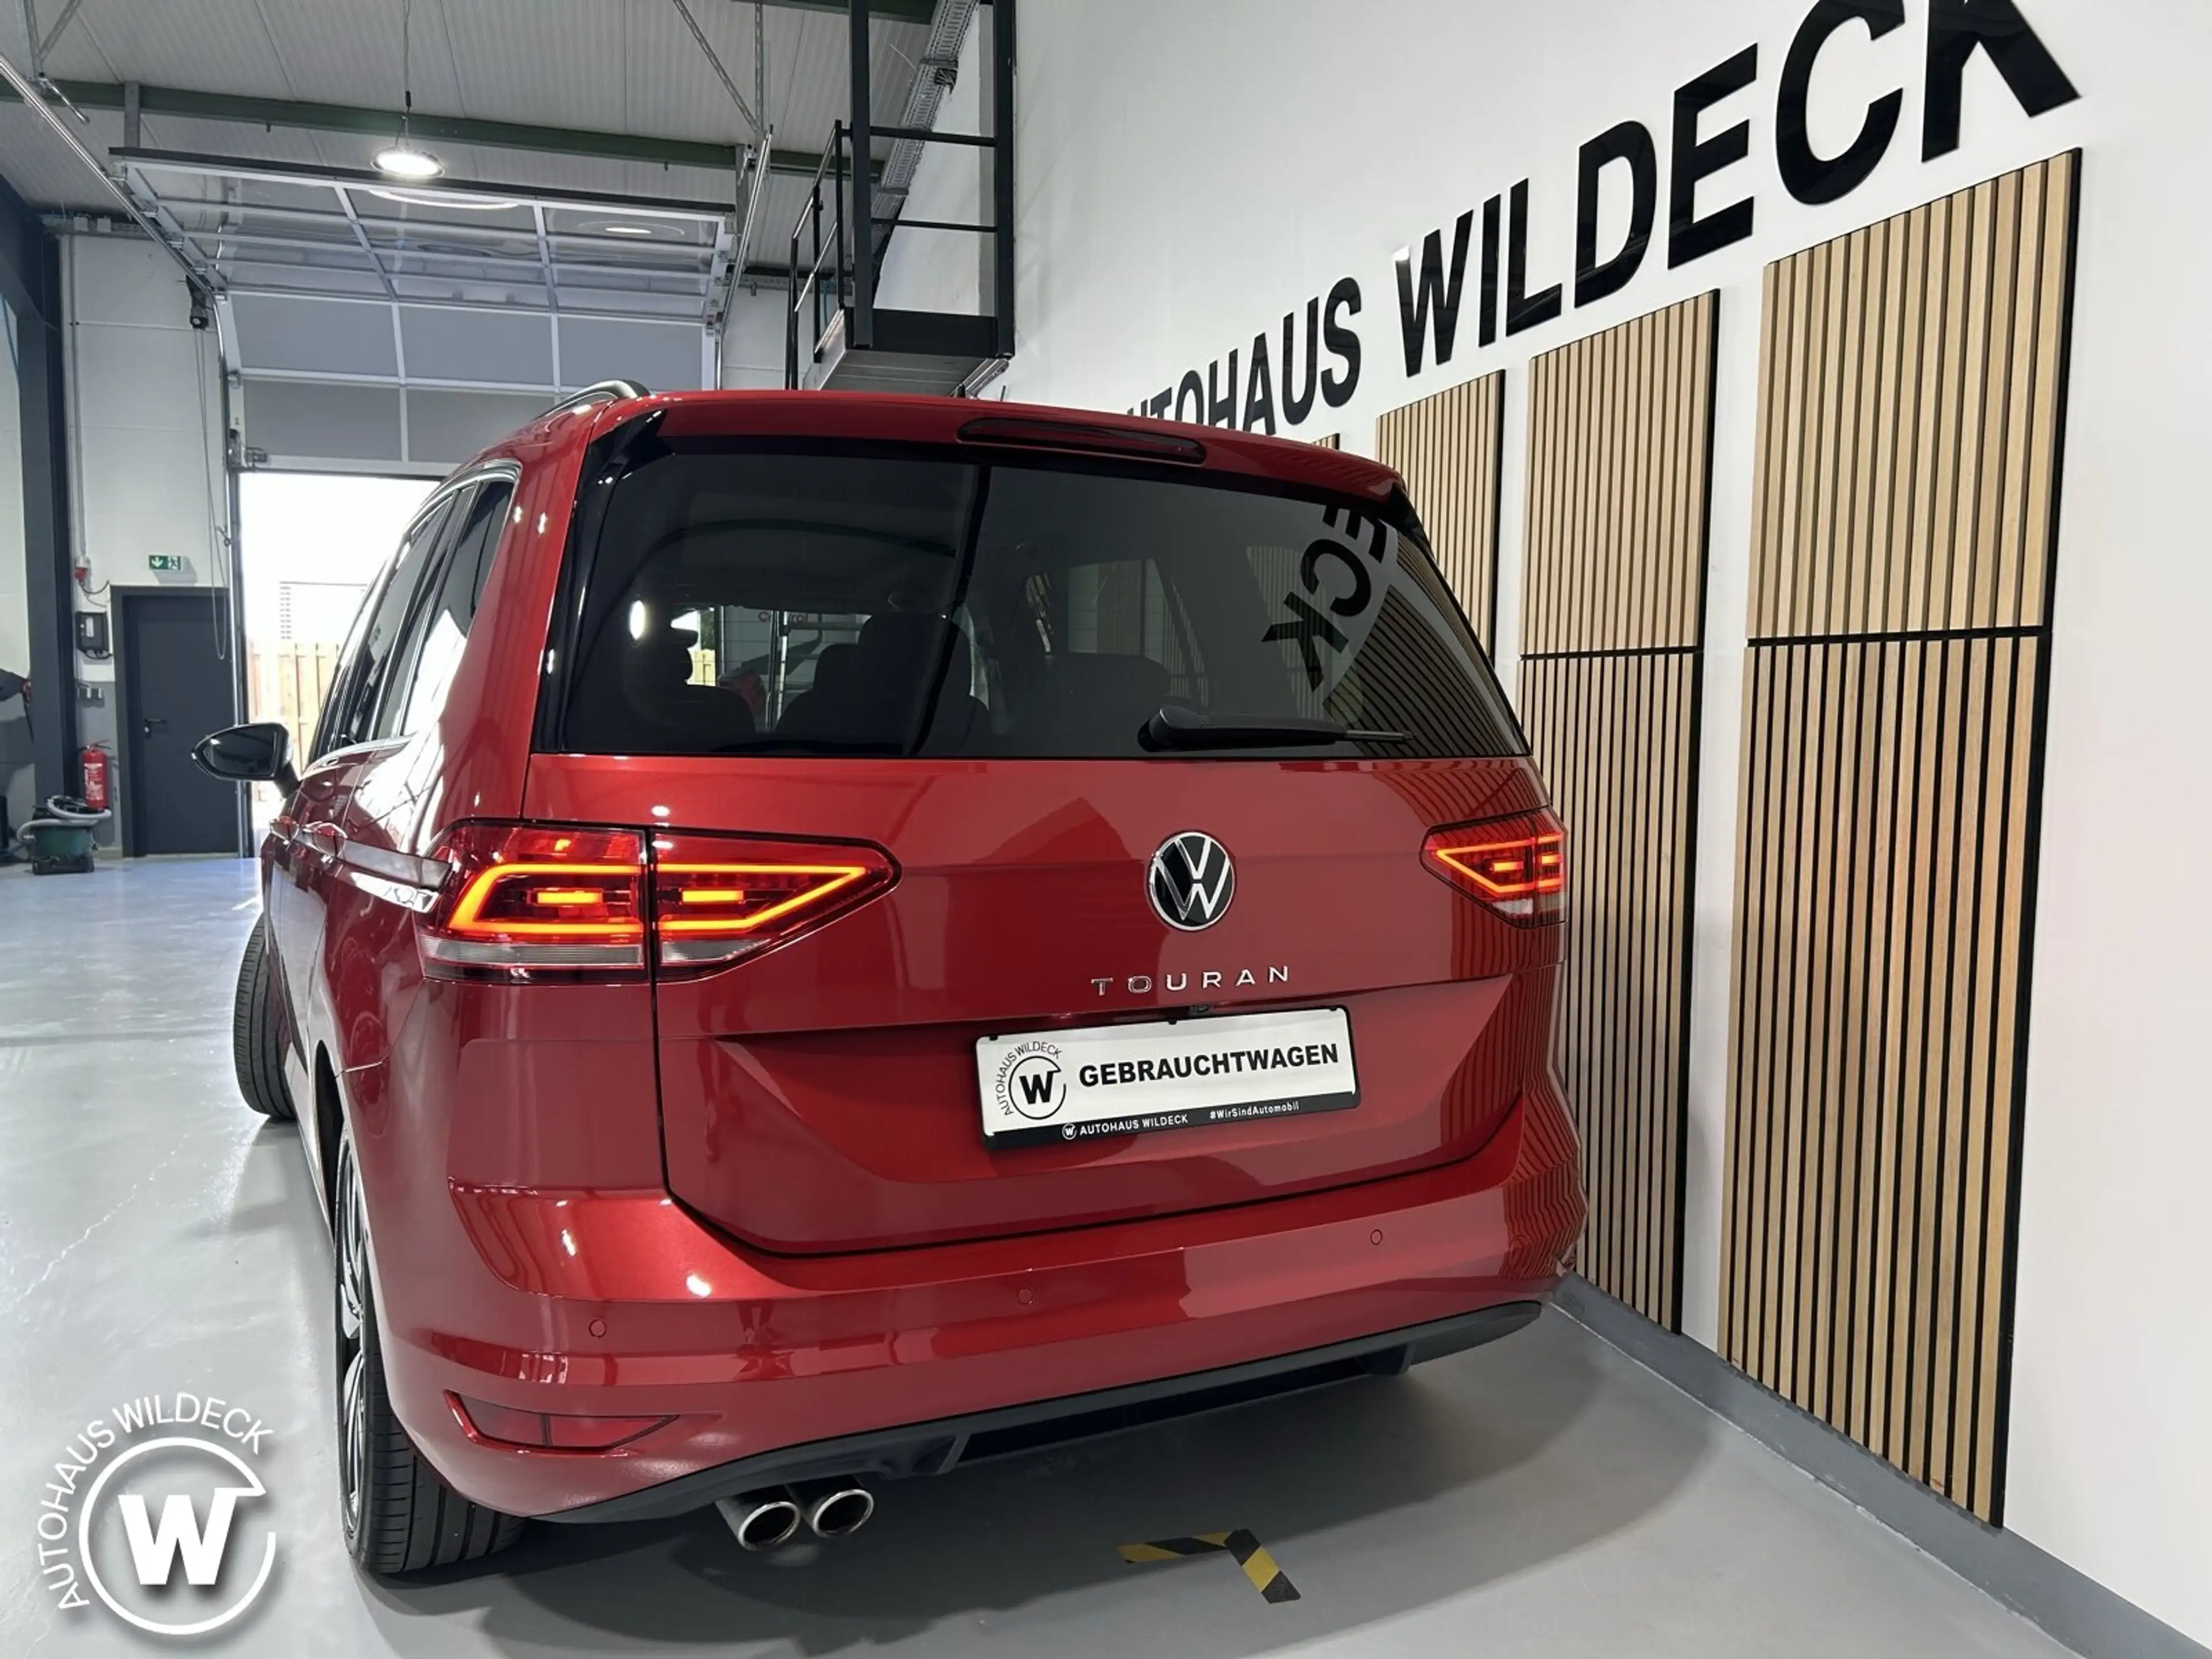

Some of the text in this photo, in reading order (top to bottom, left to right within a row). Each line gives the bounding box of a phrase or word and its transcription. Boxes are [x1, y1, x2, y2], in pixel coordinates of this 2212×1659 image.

[1127, 0, 2082, 435] TOHAUS WILDECK
[1091, 965, 1289, 996] TOURAN
[995, 1040, 1062, 1116] AUTOHAUS WILDECK
[1079, 1043, 1339, 1088] GEBRAUCHTWAGEN
[1018, 1070, 1054, 1105] W
[1079, 1119, 1139, 1136] AUTOHAUS
[1141, 1114, 1189, 1128] WILDECK
[1210, 1100, 1299, 1120] #WirSindAutomobil
